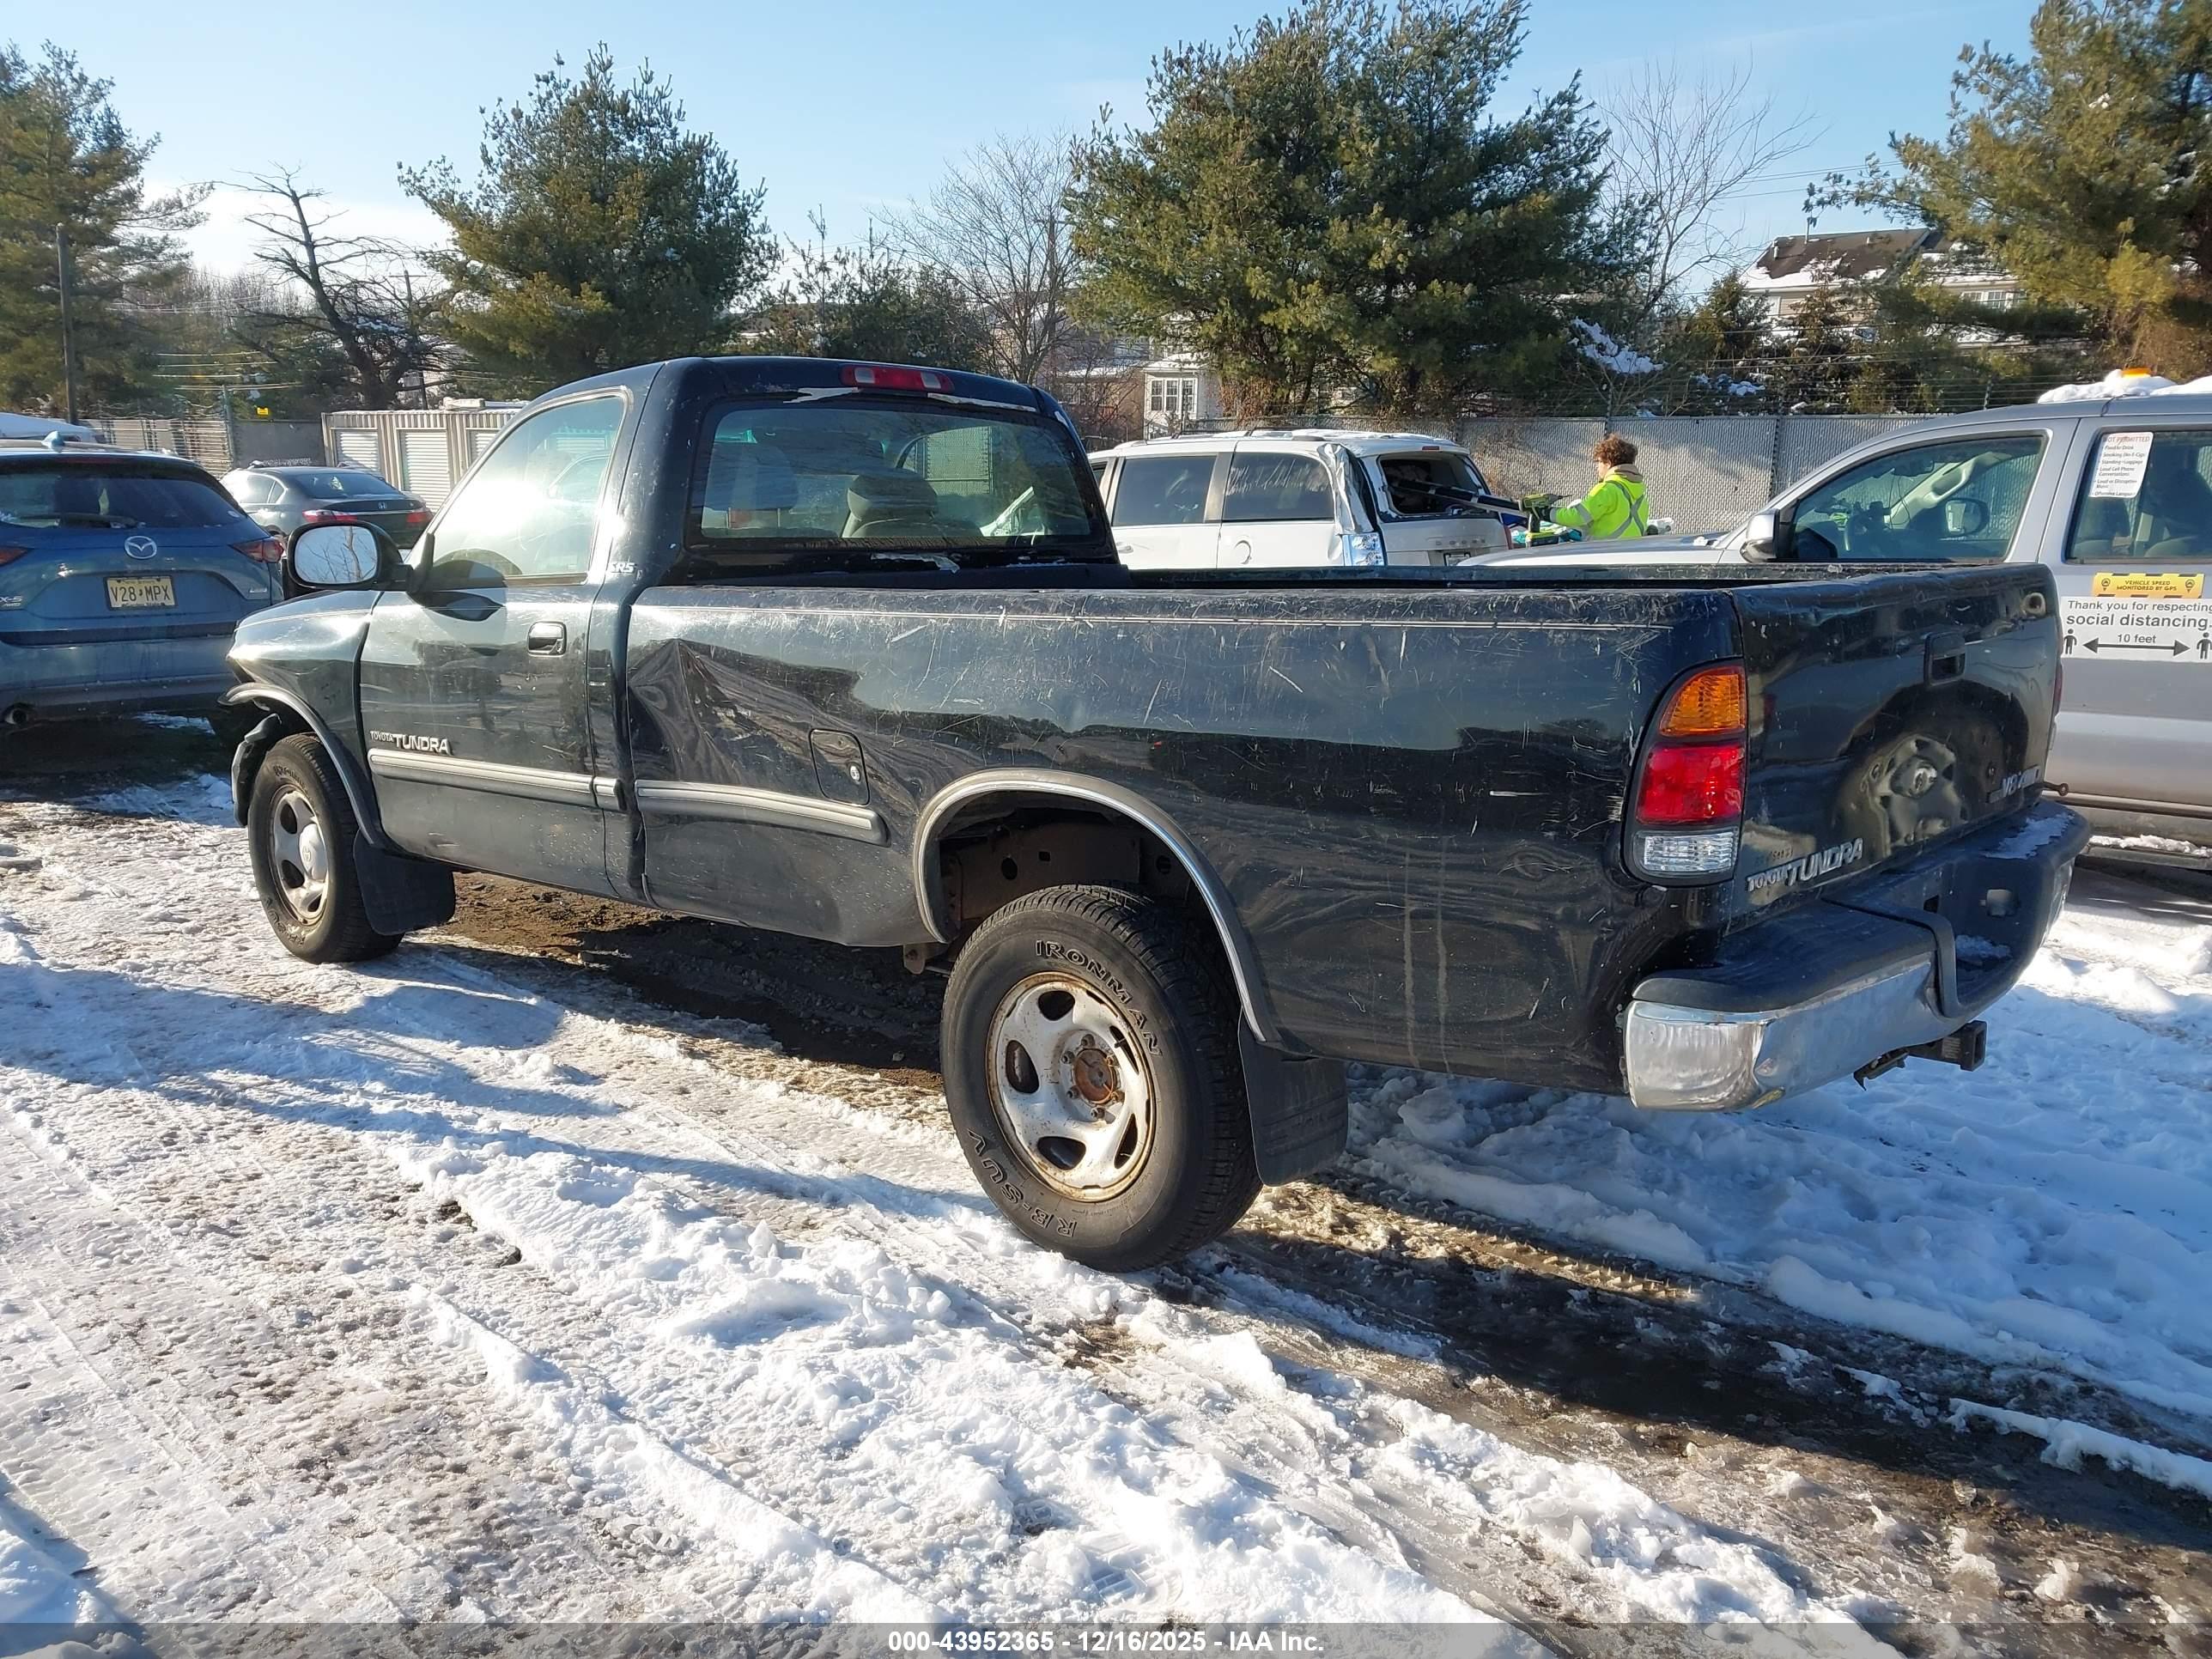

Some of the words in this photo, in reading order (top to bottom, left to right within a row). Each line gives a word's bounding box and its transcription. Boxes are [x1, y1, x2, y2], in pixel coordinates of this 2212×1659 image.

[2068, 600, 2103, 610] Thank
[2107, 603, 2129, 611] you
[2132, 601, 2149, 611] for
[2066, 613, 2114, 625] social
[2118, 634, 2130, 642] 10
[2135, 635, 2157, 643] feet
[370, 731, 395, 743] TOYOTA
[392, 733, 450, 753] TUNDRA
[1784, 837, 1863, 887] TUNDRA
[1036, 939, 1163, 1056] IRONMAN
